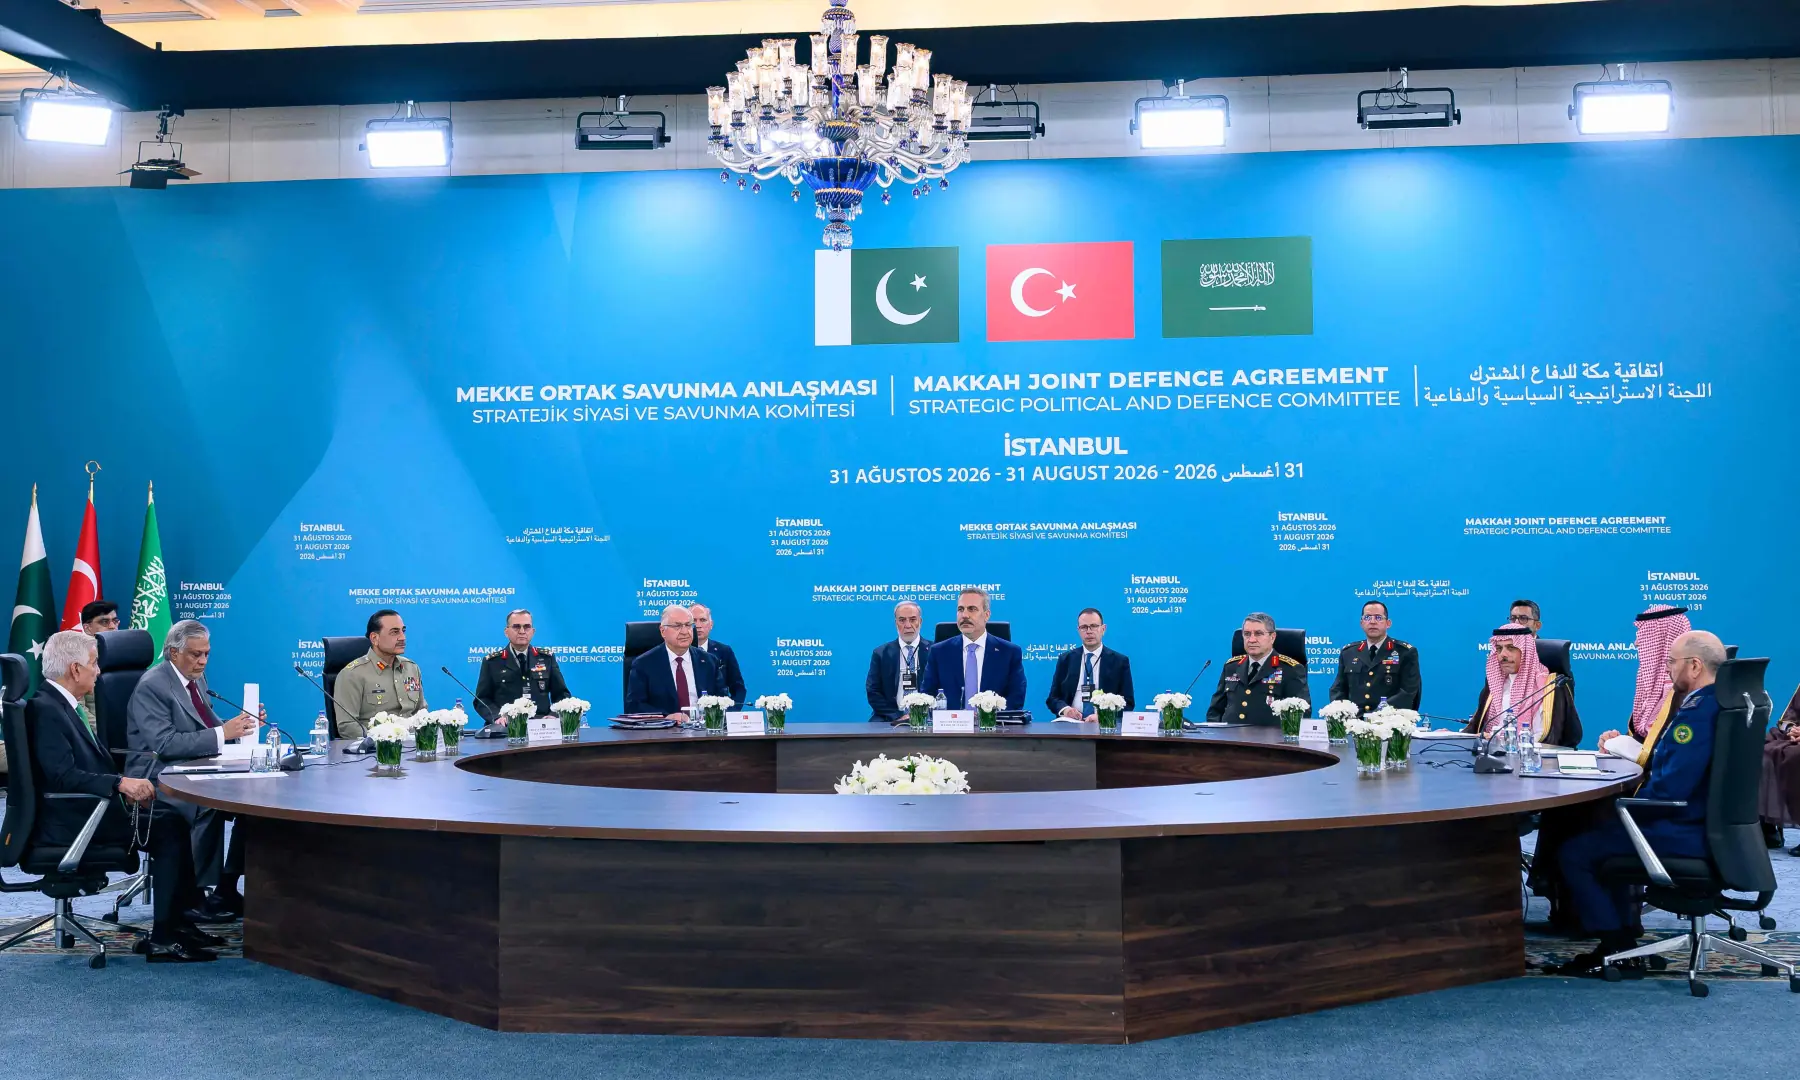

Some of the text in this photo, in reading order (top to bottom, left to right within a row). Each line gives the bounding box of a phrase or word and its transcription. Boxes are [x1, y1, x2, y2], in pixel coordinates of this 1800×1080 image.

[1470, 361, 1663, 387] اتفاقية مكة للدفاع المشترك
[914, 367, 1389, 392] MAKKAH JOINT DEFENCE AGREEMENT
[457, 379, 877, 403] MEKKE ORTAK SAVUNMA ANLAŞMASI
[1424, 383, 1711, 407] اللجنة الاستراتيجية السياسية والدفاعية
[909, 391, 1400, 415] STRATEGIC POLITICAL AND DEFENCE COMMITTEE
[473, 400, 855, 424] STRATEJİK SİYASİ VE SAVUNMA KOMİTESİ
[1004, 432, 1128, 457] İSTANBUL
[855, 465, 942, 484] AĞUSTOS
[947, 467, 991, 483] 2026
[1006, 467, 1025, 482] 31
[1032, 465, 1110, 481] AUGUST
[1114, 465, 1158, 480] 2026
[1174, 464, 1217, 480] 2026
[1221, 461, 1279, 483] أغسطس
[1285, 462, 1303, 478] 31
[830, 469, 848, 484] 31
[1278, 511, 1328, 522] İSTANBUL
[1465, 516, 1666, 526] MAKKAH JOINT DEFENCE AGREEMENT
[300, 522, 345, 532] İSTANBUL
[776, 517, 823, 527] İSTANBUL
[960, 522, 1137, 532] MEKKE ORTAK SAVUNMA ANLAŞMASI
[1281, 523, 1317, 531] AĞUSTOS
[778, 529, 813, 537] AĞUSTOS
[967, 532, 1008, 540] STRATEJİK
[1009, 532, 1034, 540] SİYASİ
[1090, 531, 1128, 539] KOMİTESİ
[1463, 526, 1671, 535] STRATEGIC POLITICAL AND DEFENCE COMMITTEE
[781, 538, 810, 546] AUGUST
[1283, 533, 1315, 541] AUGUST
[1316, 533, 1335, 541] 2026
[1279, 543, 1297, 551] 2026
[1322, 543, 1330, 551] 31
[1131, 574, 1180, 584] İSTANBUL
[1647, 570, 1700, 581] İSTANBUL
[180, 581, 224, 591] İSTANBUL
[644, 578, 690, 588] İSTANBUL
[1651, 583, 1688, 591] AĞUSTOS
[349, 587, 515, 598] MEKKE ORTAK SAVUNMA ANLAŞMASI
[646, 589, 679, 597] AĞUSTOS
[814, 585, 857, 593] MAKKAH
[891, 584, 937, 592] DEFENCE
[1134, 586, 1169, 594] AĞUSTOS
[356, 597, 394, 605] STRATEJİK
[471, 596, 506, 604] KOMİTESİ
[812, 594, 854, 602] STRATEGIC
[1137, 596, 1168, 604] AUGUST
[1169, 596, 1187, 604] 2026
[1654, 593, 1686, 601] AUGUST
[1688, 593, 1707, 601] 2026
[1132, 606, 1149, 614] 2026
[1694, 603, 1702, 611] 31
[777, 637, 824, 647] İSTANBUL
[779, 649, 814, 657] AĞUSTOS
